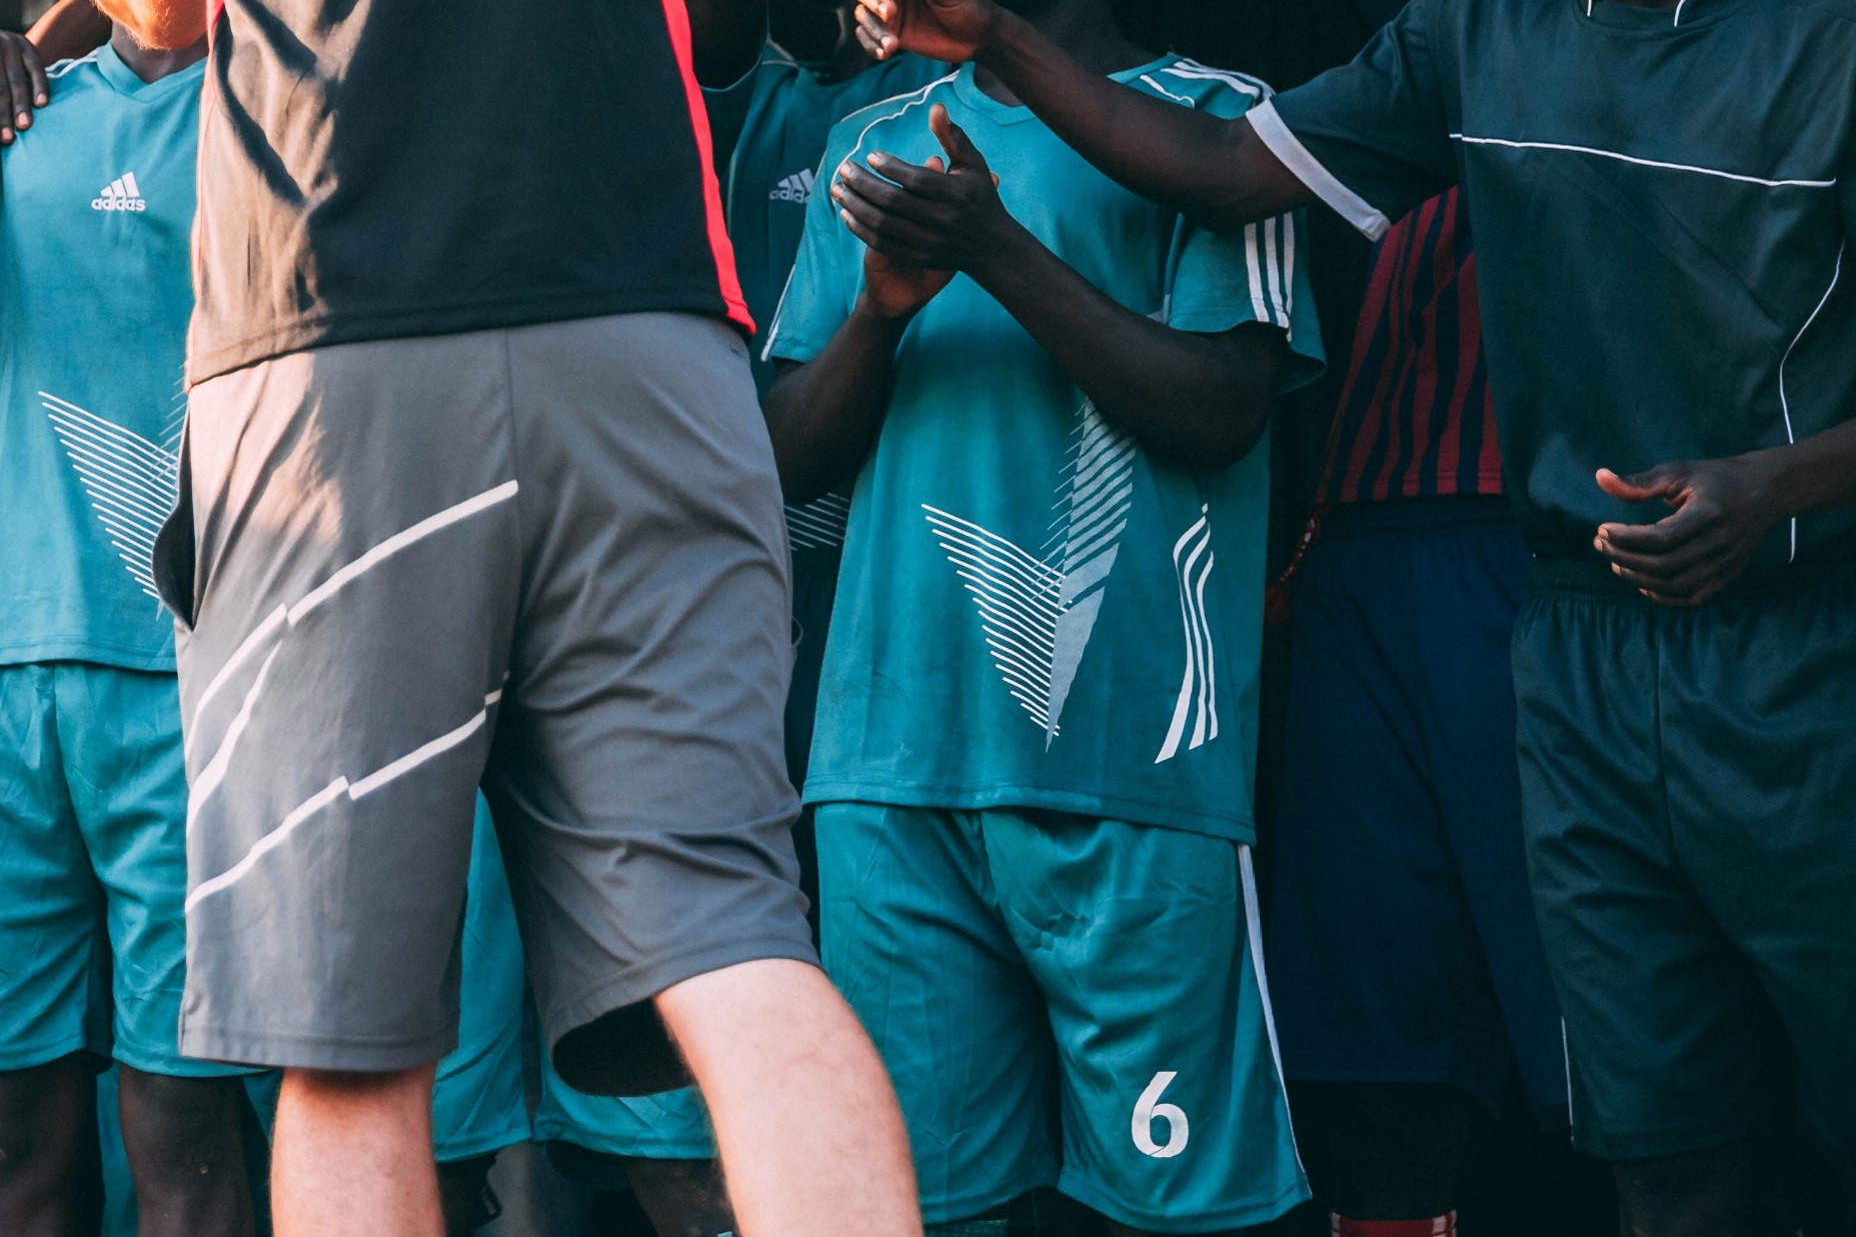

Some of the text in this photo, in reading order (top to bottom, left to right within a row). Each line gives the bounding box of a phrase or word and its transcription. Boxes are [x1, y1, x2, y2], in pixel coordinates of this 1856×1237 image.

[91, 195, 146, 212] adidas
[769, 186, 810, 204] adid
[1131, 1071, 1189, 1158] 6
